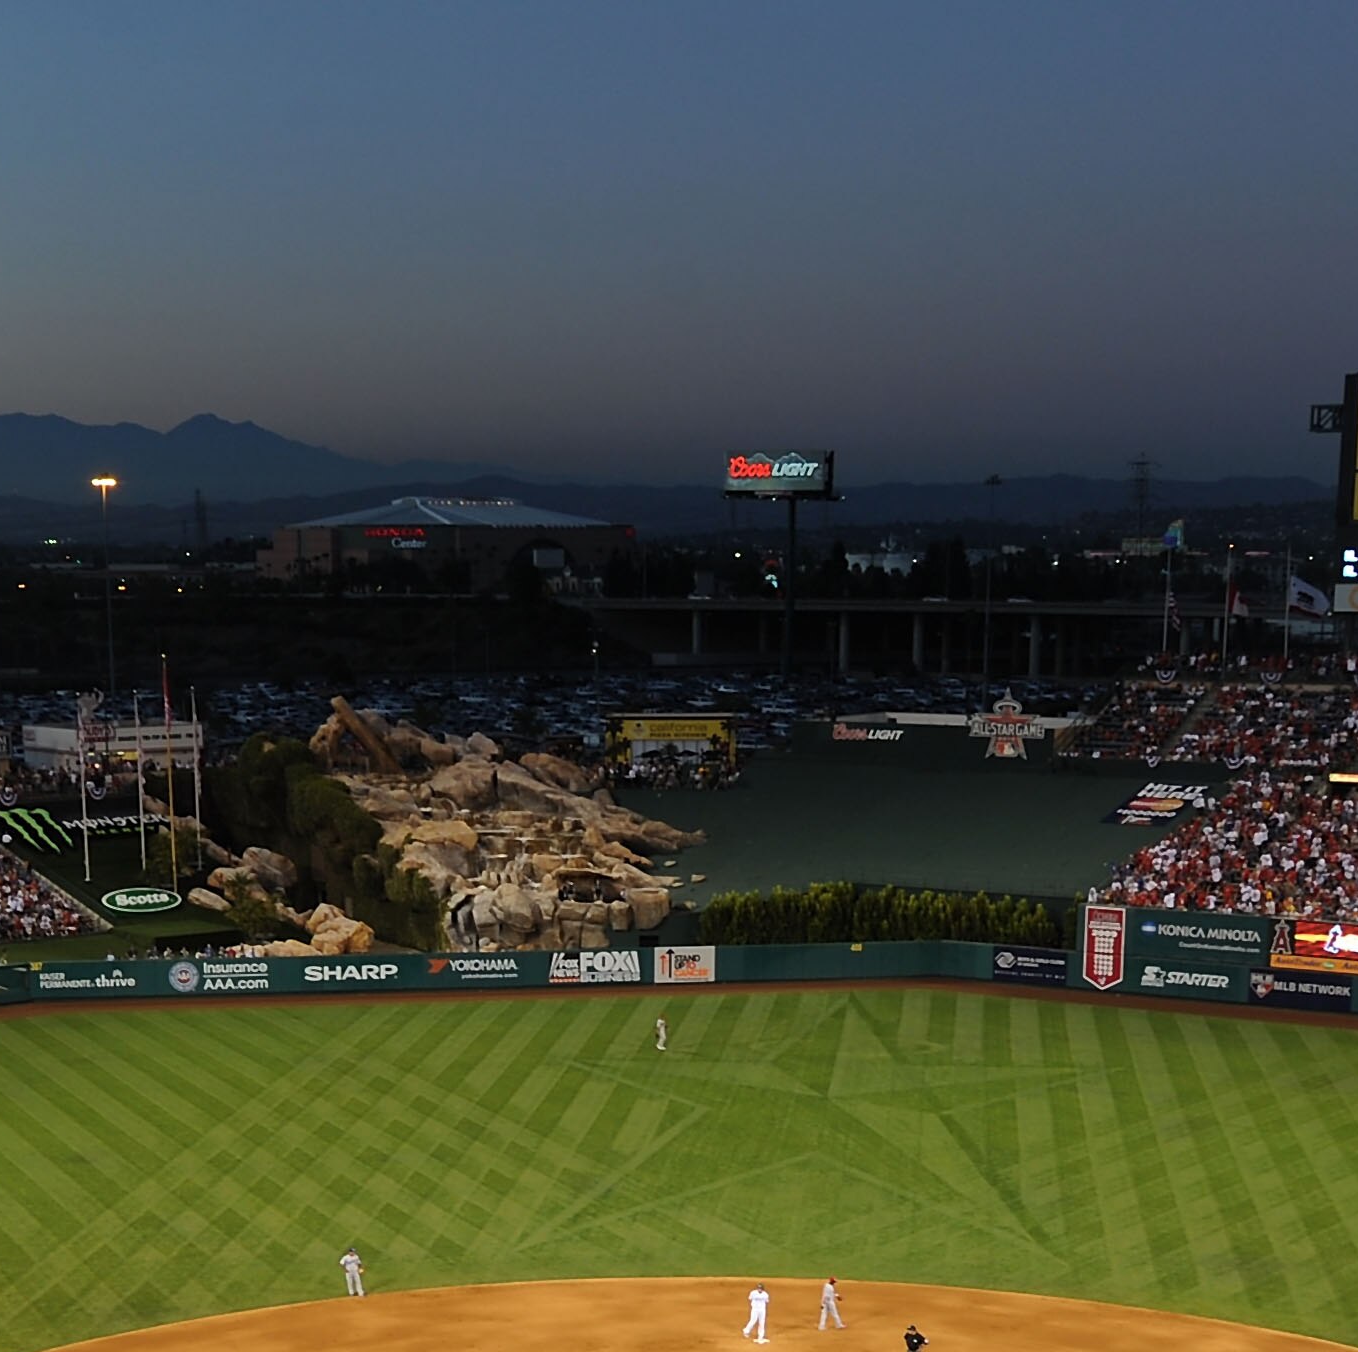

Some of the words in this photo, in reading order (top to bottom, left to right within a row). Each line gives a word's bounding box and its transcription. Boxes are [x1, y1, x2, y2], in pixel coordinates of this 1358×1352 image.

[728, 454, 771, 479] Coors
[772, 460, 820, 479] LIGHT
[392, 537, 428, 549] Center
[867, 729, 904, 741] LIGHT
[115, 893, 170, 907] Scotts
[1158, 923, 1206, 938] KONICA
[1207, 929, 1261, 943] MINOLTA
[203, 962, 268, 975] Insurance
[449, 958, 518, 971] YOKOHAMA
[580, 951, 629, 973] FOX
[95, 973, 136, 988] thrive
[304, 964, 398, 982] SHARP
[1165, 971, 1229, 988] STARTER
[203, 977, 269, 991] AAA.com
[1273, 981, 1296, 992] MLB
[1298, 982, 1352, 997] NETWORK
